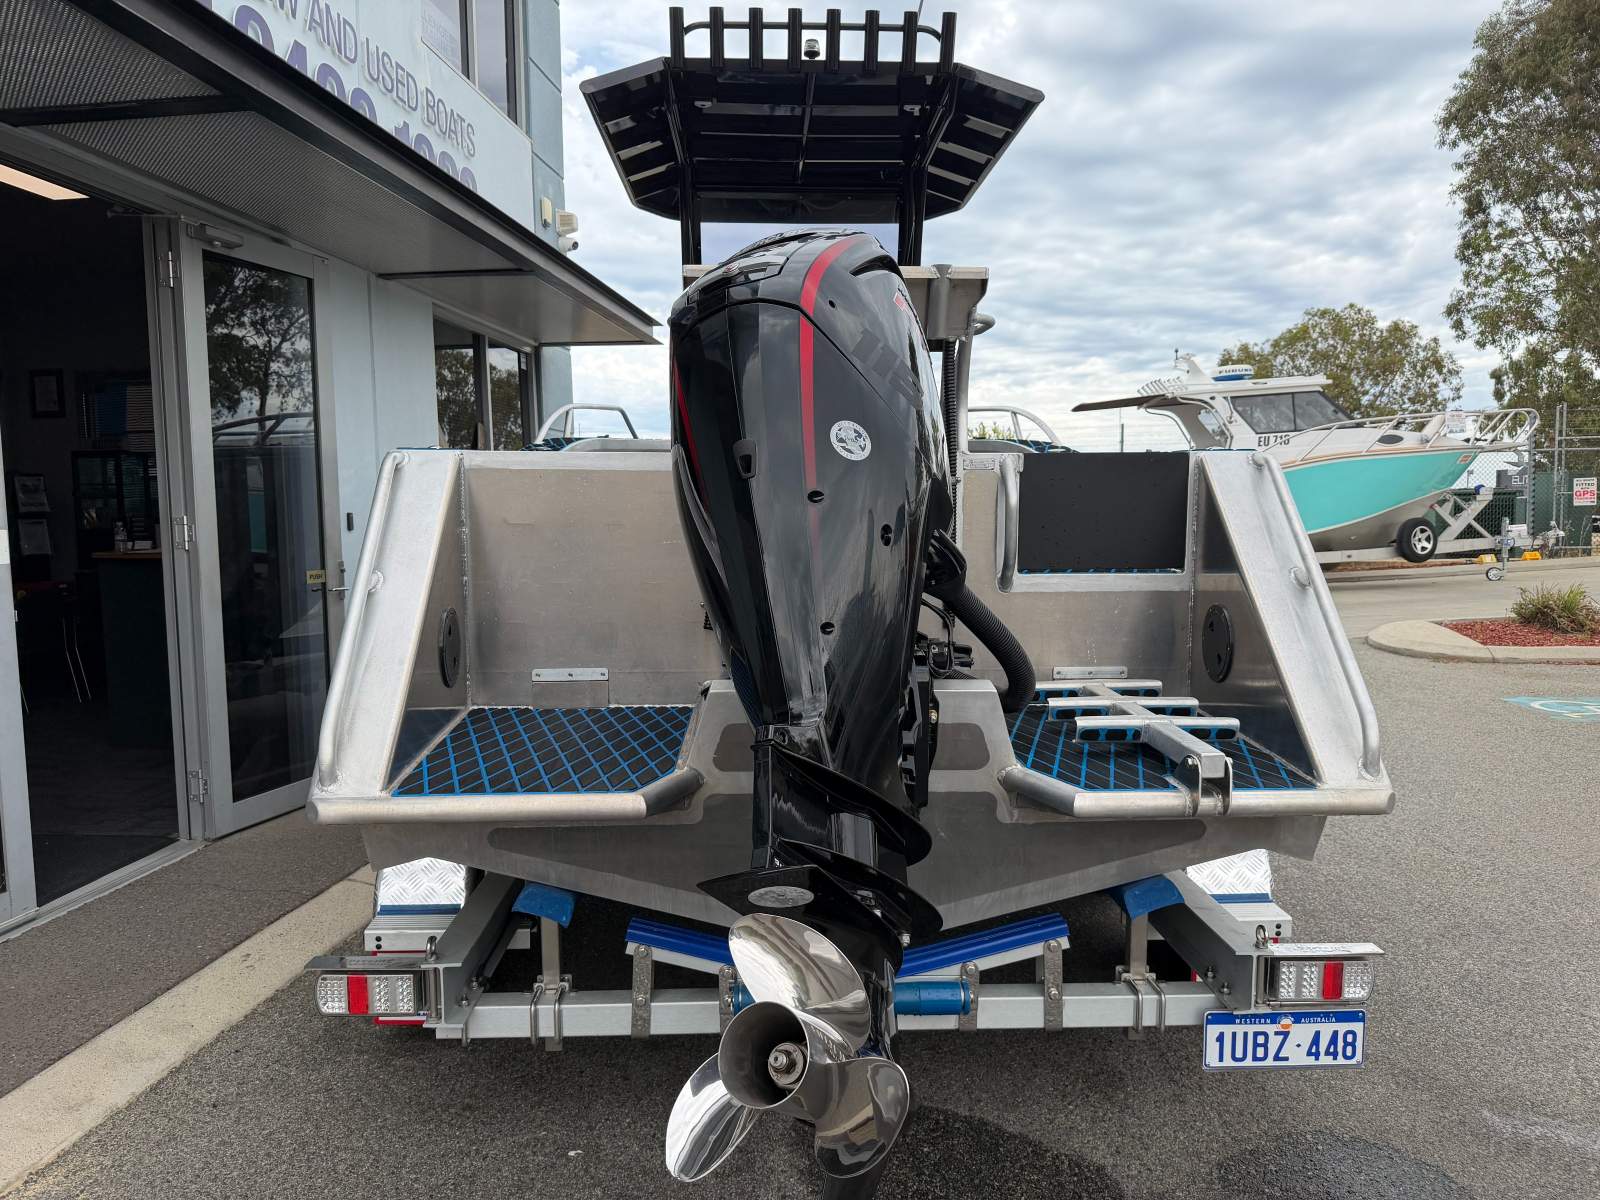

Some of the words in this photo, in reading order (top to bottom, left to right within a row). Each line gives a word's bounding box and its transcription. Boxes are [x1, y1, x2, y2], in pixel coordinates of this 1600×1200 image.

[306, 0, 358, 64] AND
[365, 37, 419, 112] USED
[424, 86, 476, 157] BOATS
[1257, 435, 1271, 447] EU
[1574, 489, 1596, 497] GPS
